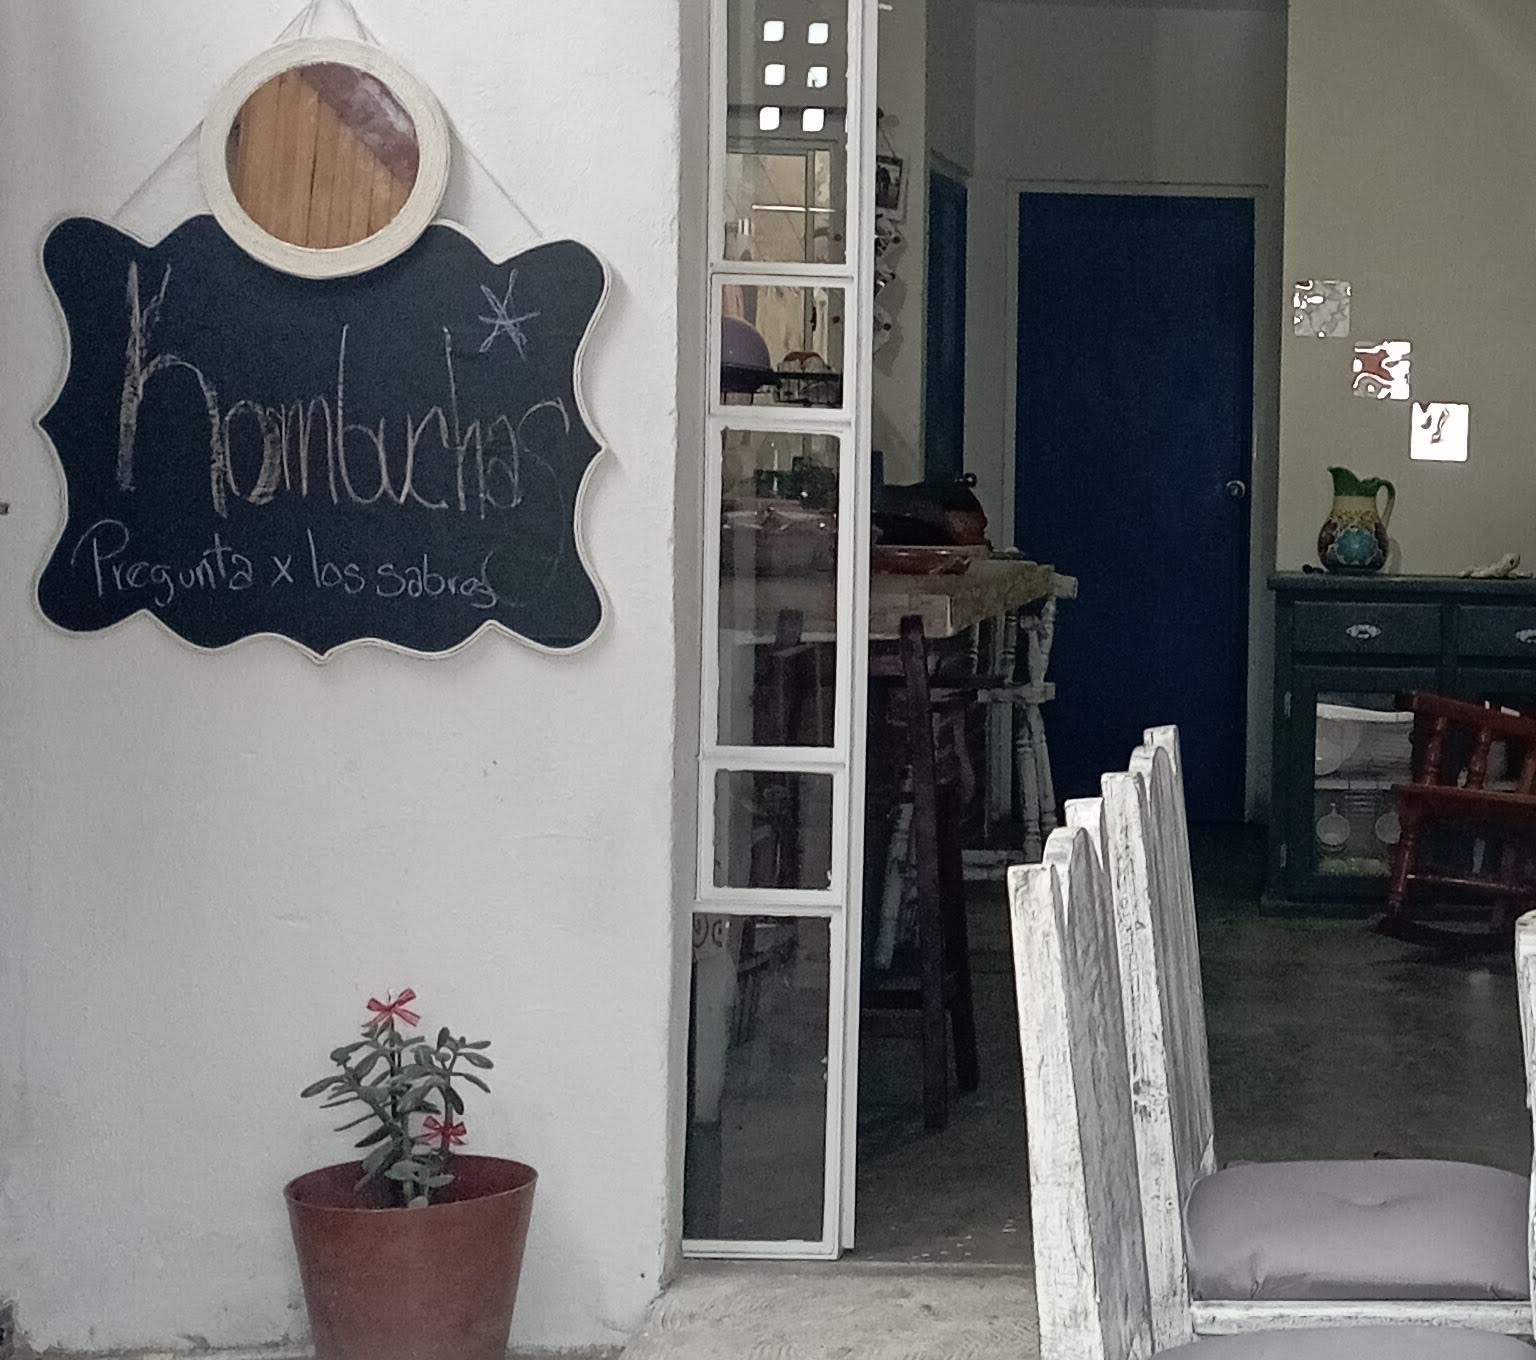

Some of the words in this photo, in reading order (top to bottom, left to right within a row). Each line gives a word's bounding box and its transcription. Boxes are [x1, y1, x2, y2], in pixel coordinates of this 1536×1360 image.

[72, 519, 253, 606] Pregunta
[271, 555, 294, 585] x
[306, 528, 366, 595] los
